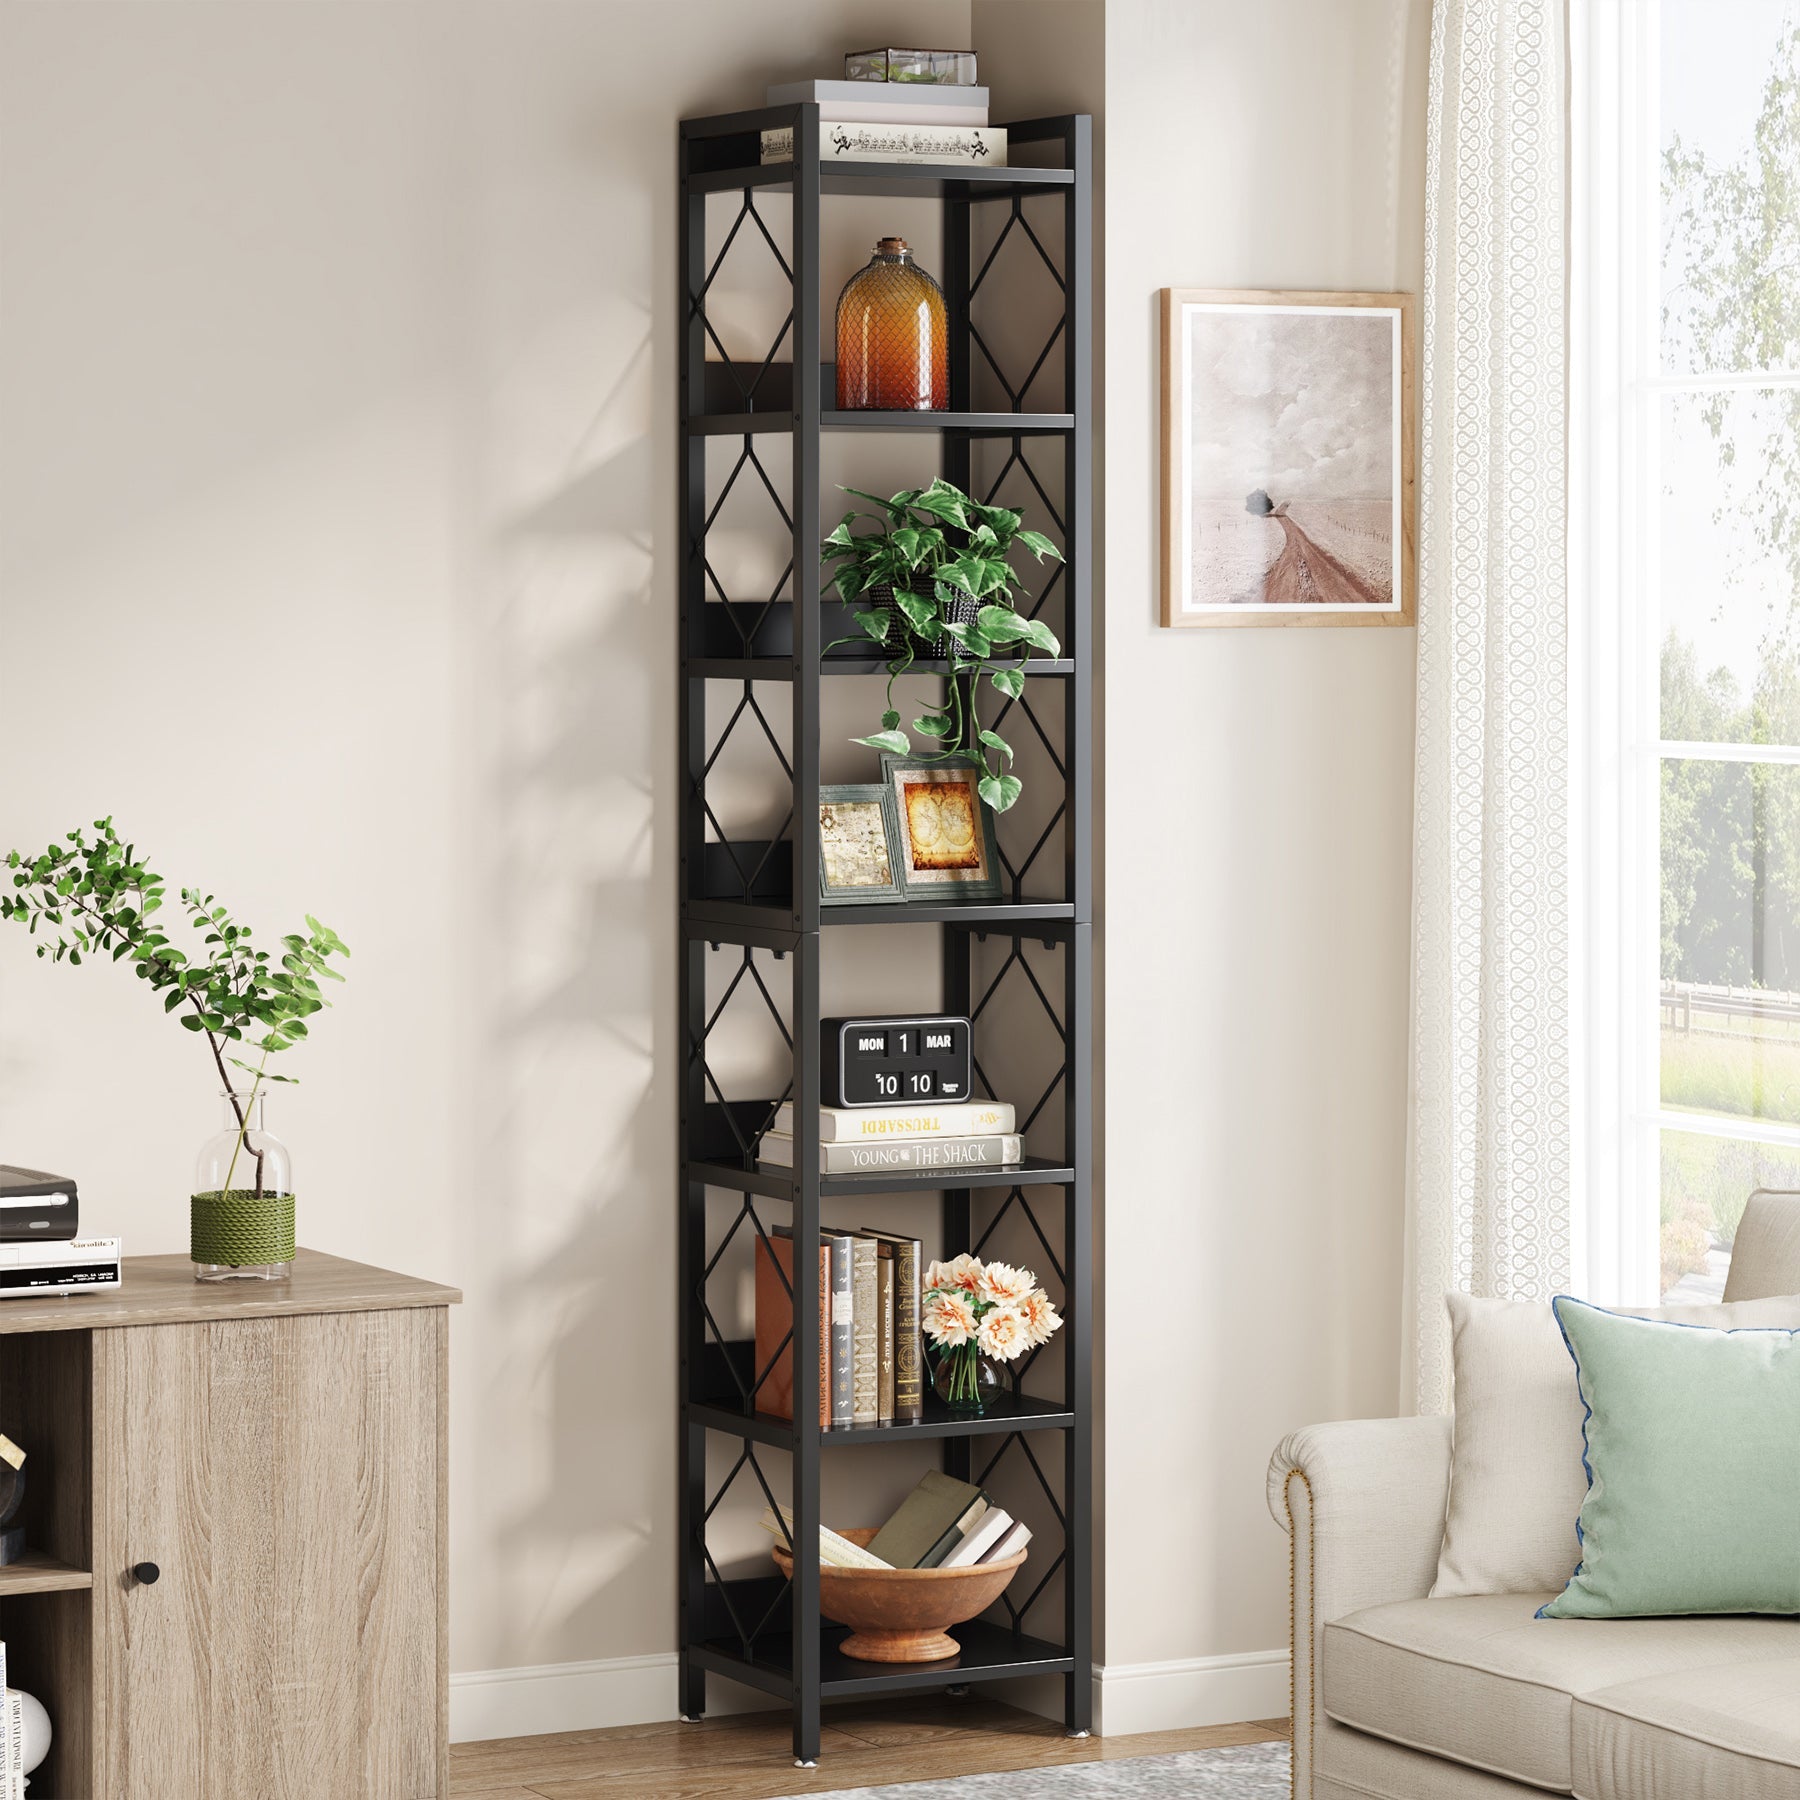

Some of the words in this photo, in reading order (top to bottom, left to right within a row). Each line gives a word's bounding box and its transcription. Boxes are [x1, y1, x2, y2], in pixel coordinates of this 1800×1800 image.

[859, 1038, 884, 1051] MON
[899, 1033, 907, 1053] 1
[926, 1035, 951, 1048] MAR
[877, 1076, 898, 1095] 10
[910, 1074, 931, 1093] 10
[861, 1117, 941, 1134] TRUSSARDI
[850, 1149, 899, 1167] YOUNG
[912, 1144, 940, 1166] THE
[943, 1143, 987, 1164] SHACK
